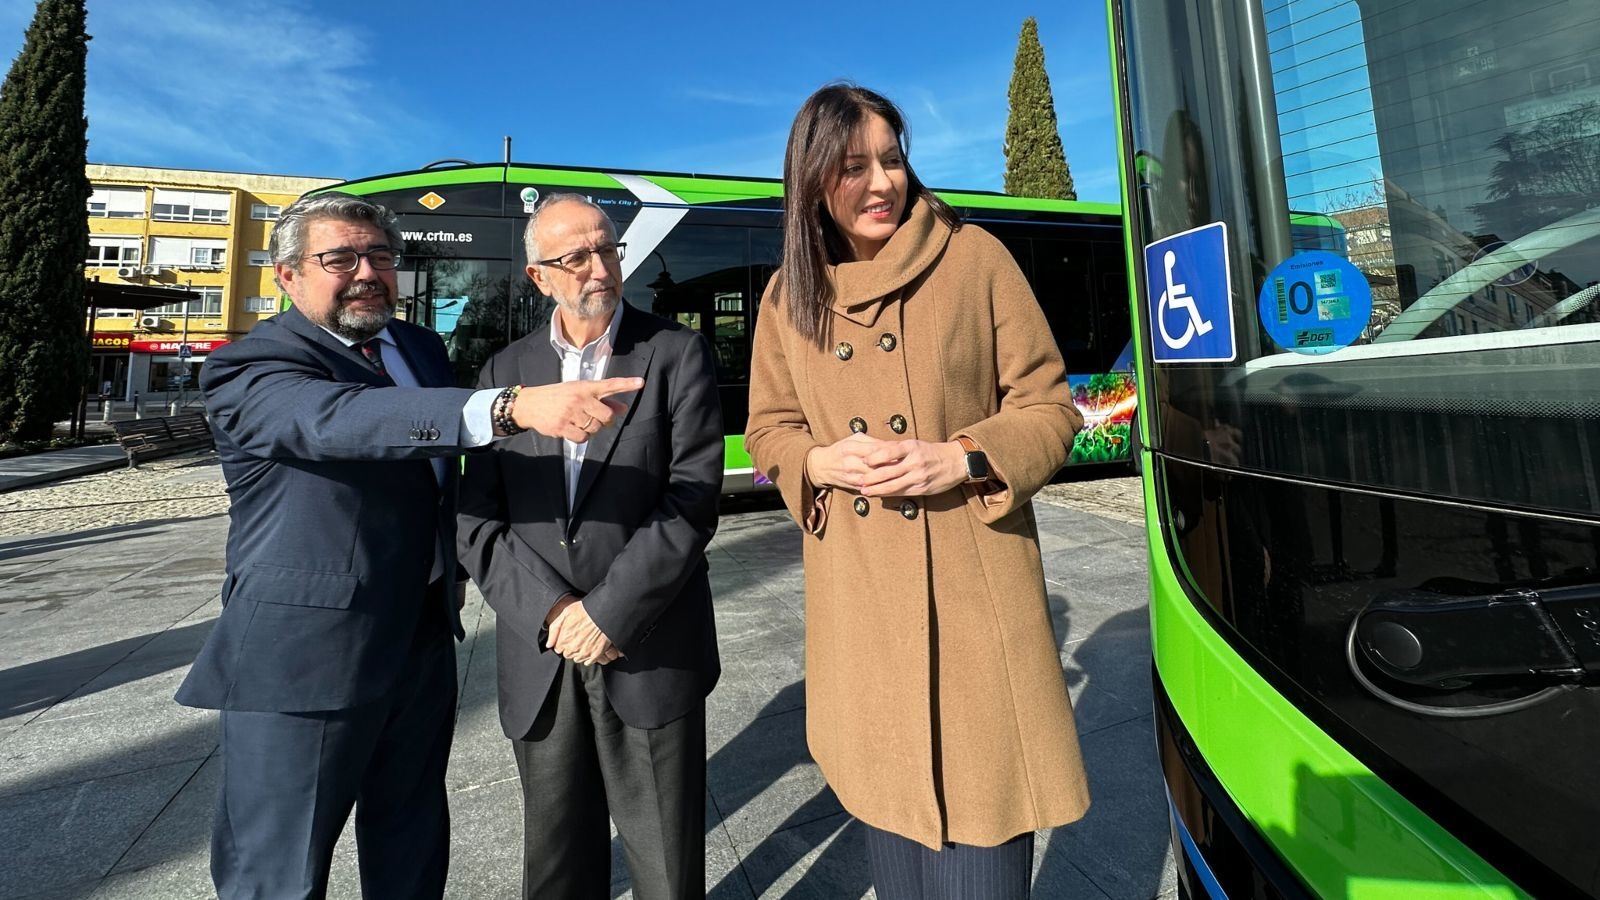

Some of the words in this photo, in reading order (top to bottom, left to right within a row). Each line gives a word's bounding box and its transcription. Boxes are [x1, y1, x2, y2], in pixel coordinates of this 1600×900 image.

[400, 230, 473, 243] ww.crtm.es
[1290, 261, 1323, 270] Emisiones
[1289, 281, 1314, 315] 0
[1310, 332, 1332, 342] DGT
[160, 342, 212, 350] MAFRE
